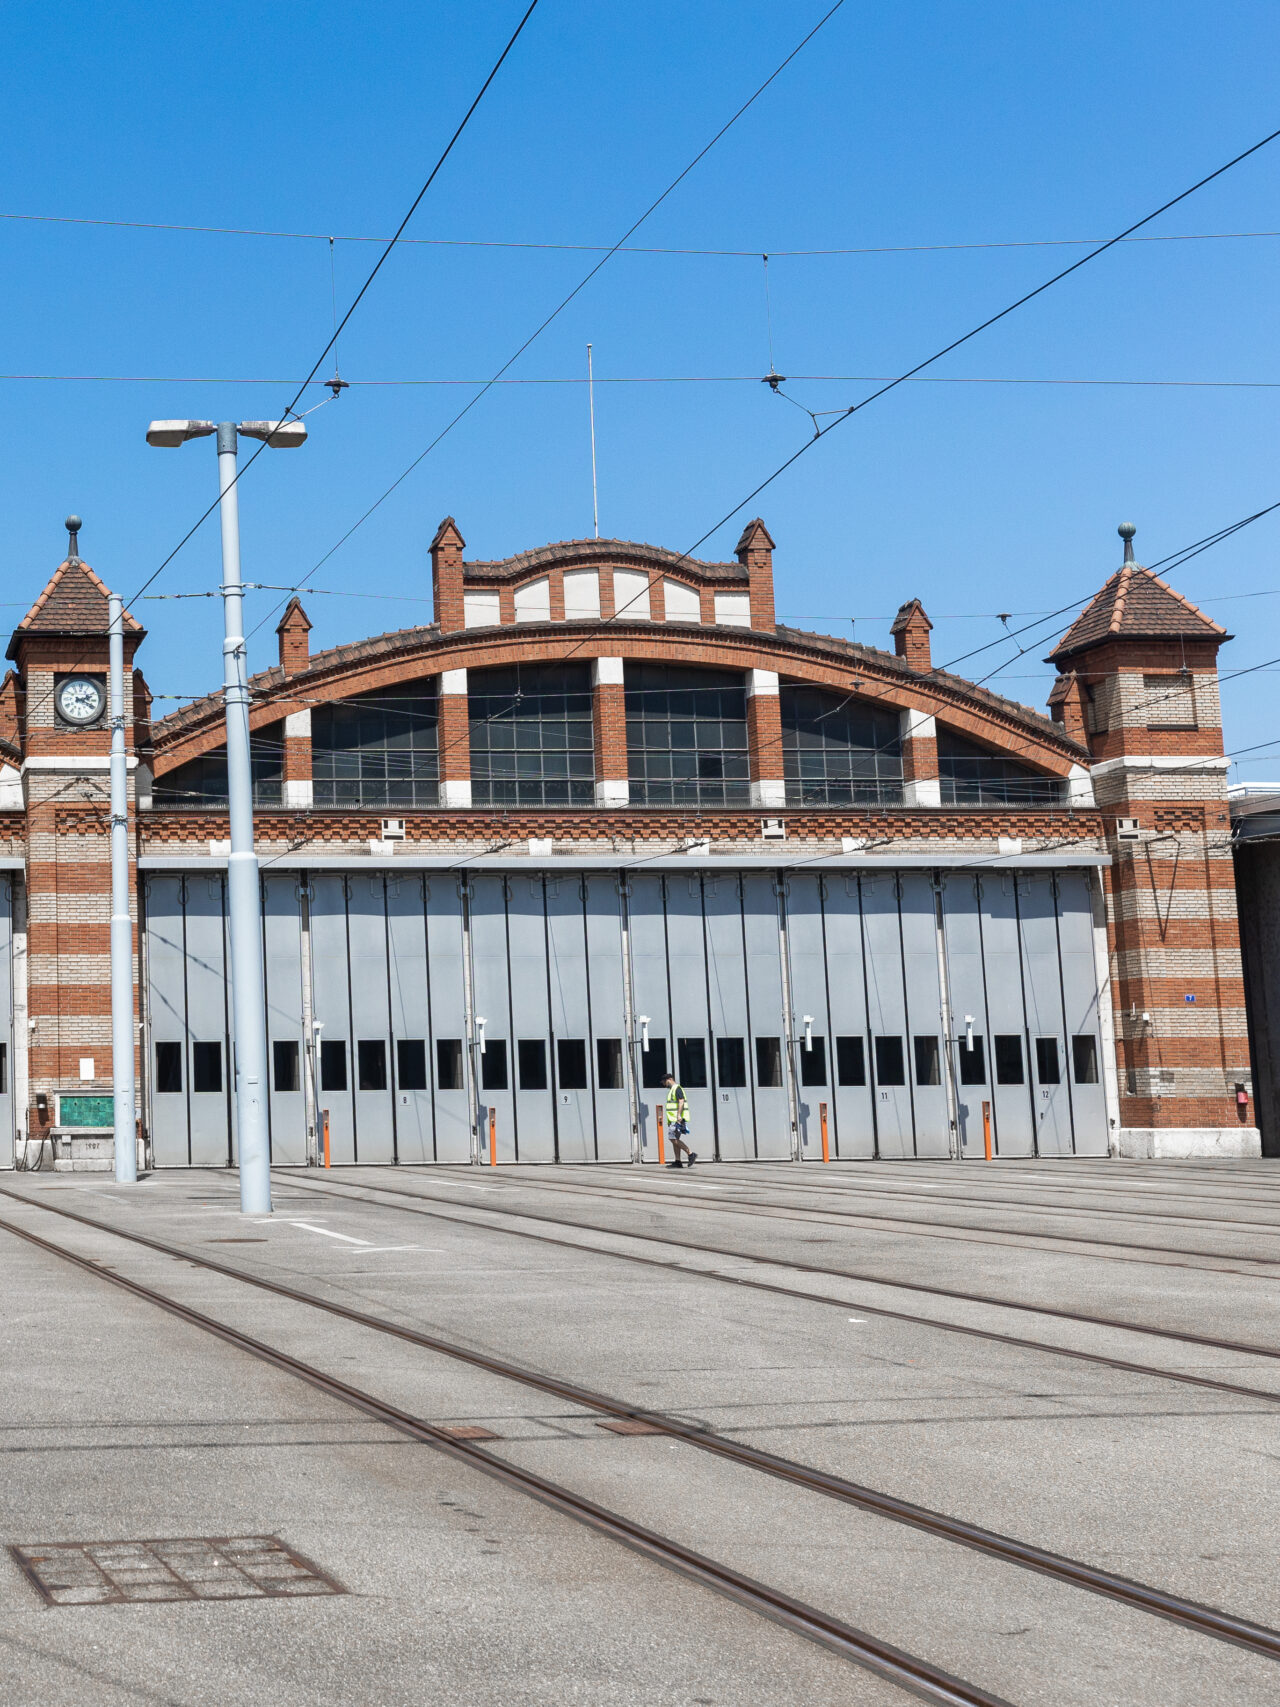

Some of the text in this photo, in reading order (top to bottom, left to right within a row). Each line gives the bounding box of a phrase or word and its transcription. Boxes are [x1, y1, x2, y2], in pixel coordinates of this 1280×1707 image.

[722, 1093, 729, 1101] 10
[1042, 1090, 1049, 1098] 12
[403, 1096, 407, 1104] 8
[564, 1095, 568, 1103] 9
